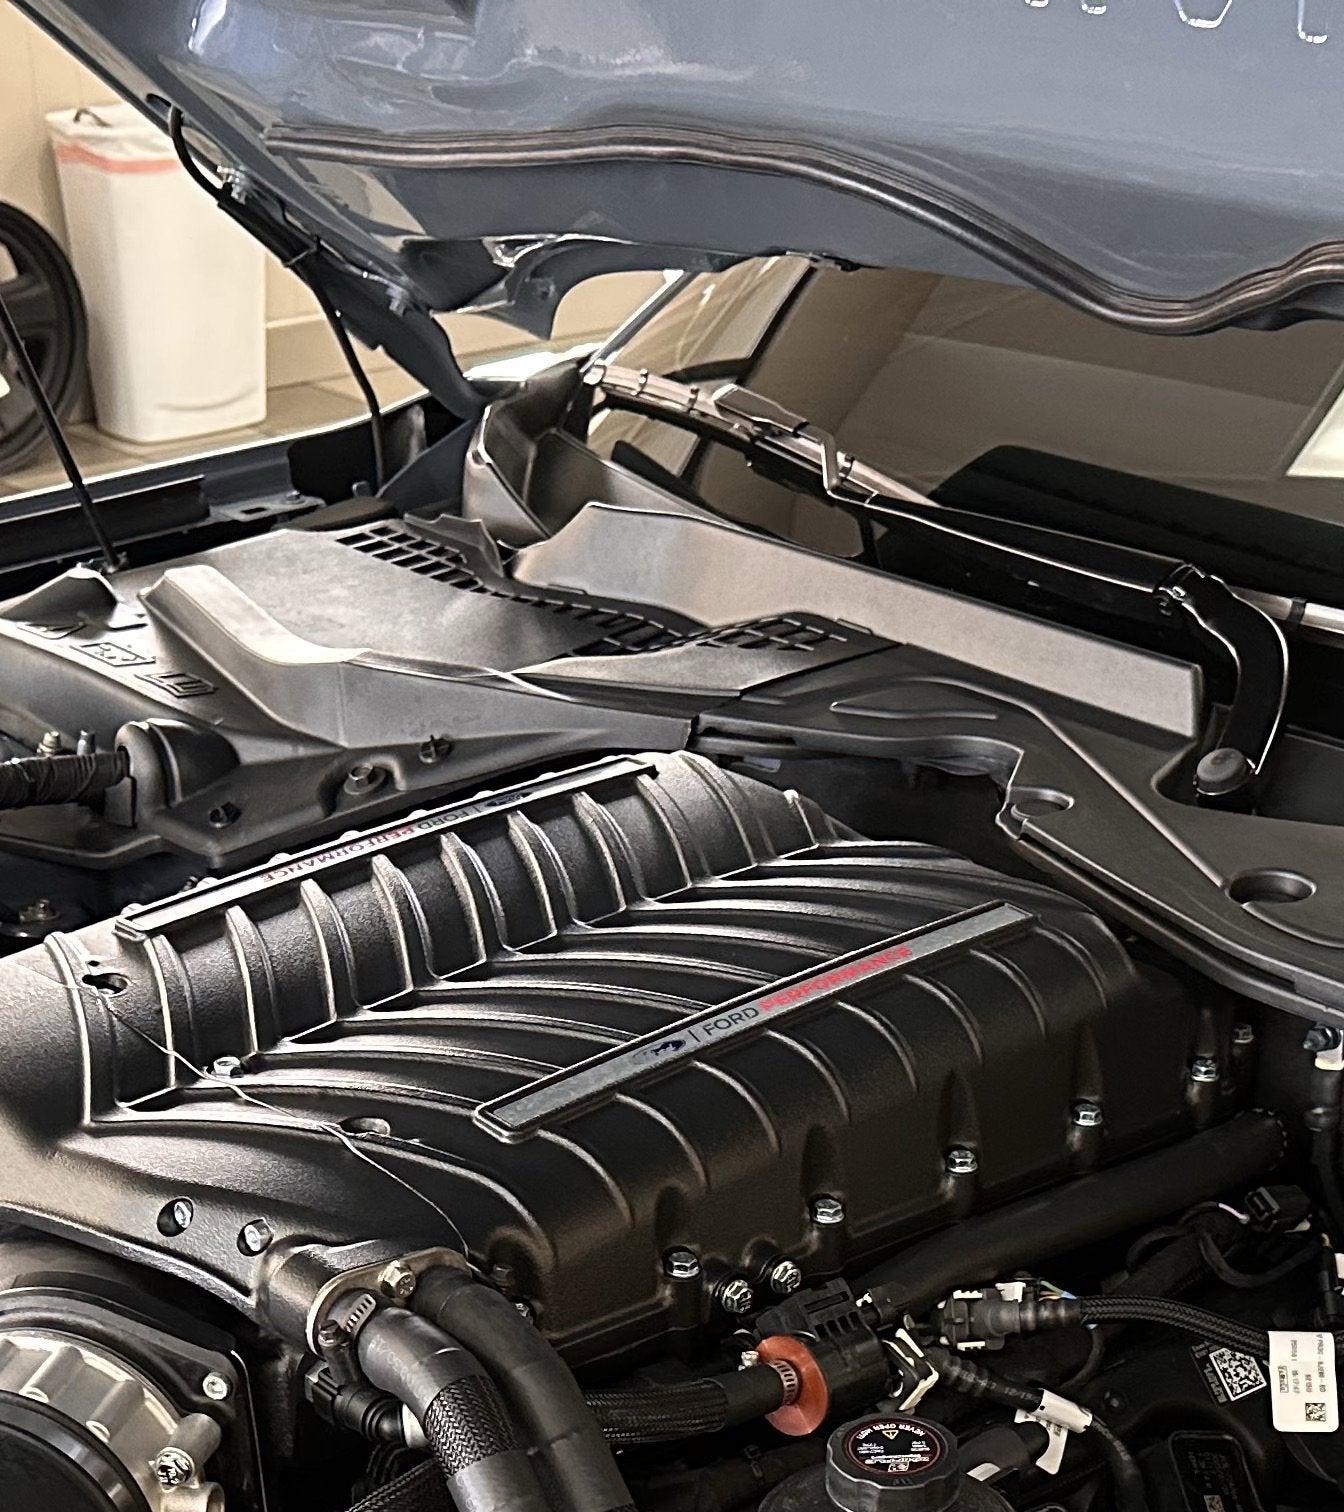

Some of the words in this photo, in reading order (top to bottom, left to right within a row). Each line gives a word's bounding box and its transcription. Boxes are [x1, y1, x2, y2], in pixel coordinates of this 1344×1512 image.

[418, 810, 472, 831] FORD
[260, 826, 416, 884] PERFORMANCE
[701, 1006, 760, 1037] FORD
[758, 943, 913, 1012] PERFORMANCE
